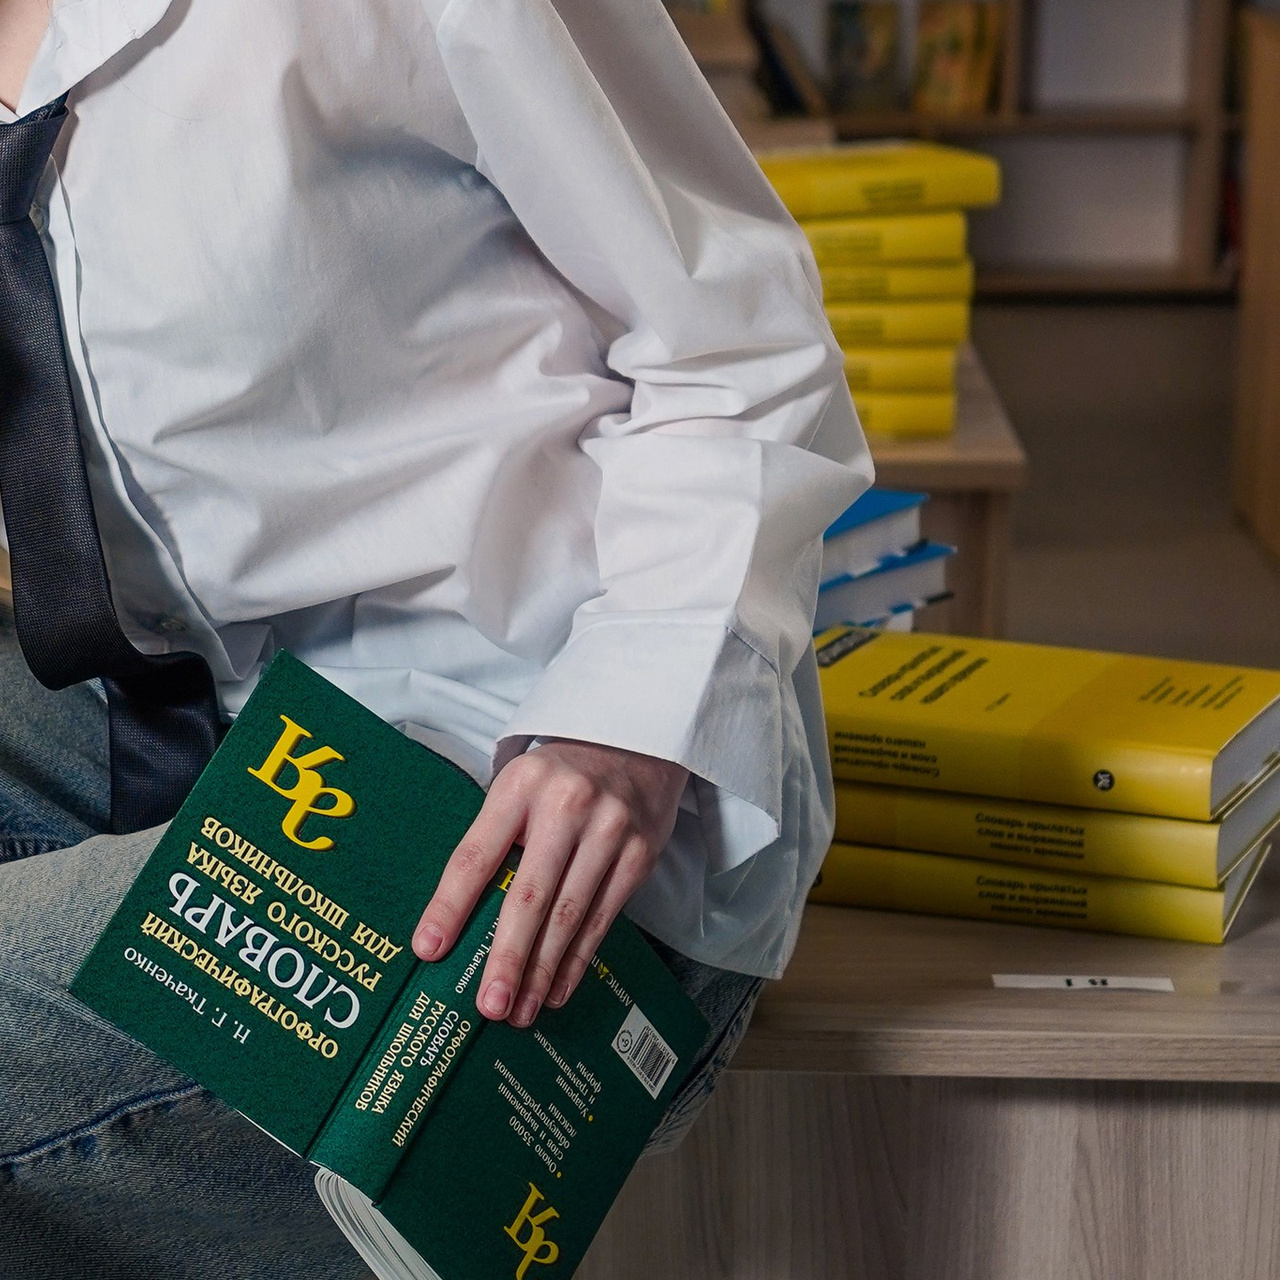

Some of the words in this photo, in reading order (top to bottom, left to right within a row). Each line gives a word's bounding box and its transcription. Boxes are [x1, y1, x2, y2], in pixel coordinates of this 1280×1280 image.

[187, 842, 263, 904] ЯЗЫКА
[201, 817, 350, 930] ШКОЛЬНИКОВ
[169, 873, 360, 1028] СЛОВАРЬ
[267, 902, 382, 992] РУССКОГО
[351, 922, 403, 963] ДЛЯ
[124, 948, 206, 1015] Ткаченко
[141, 912, 338, 1058] ОРФОГРАФИЧЕСКИЙ
[455, 944, 490, 993] Ткаченко
[605, 972, 633, 1007] АЙРИС
[212, 1007, 227, 1027] Г.
[409, 991, 430, 1020] ДЛЯ
[233, 1021, 251, 1044] Н.
[401, 1001, 446, 1067] РУССКОГО
[420, 1011, 459, 1066] СЛОВАРЬ
[617, 1032, 631, 1051] 6+
[355, 1023, 414, 1110] ШКОЛЬНИКОВ
[392, 1020, 471, 1146] ОРФОГРАФИЧЕСКИЙ
[534, 1031, 589, 1097] грамматические
[575, 1061, 602, 1094] формы
[371, 1070, 404, 1113] ЯЗЫКА
[493, 1058, 571, 1150] общеупотребительной
[497, 1082, 540, 1132] выражений
[555, 1074, 589, 1118] Ударения
[587, 1094, 596, 1105] и
[508, 1115, 535, 1147] 35000
[538, 1130, 547, 1141] и
[547, 1102, 576, 1137] лексики
[534, 1143, 557, 1174] Около
[545, 1138, 564, 1161] слов
